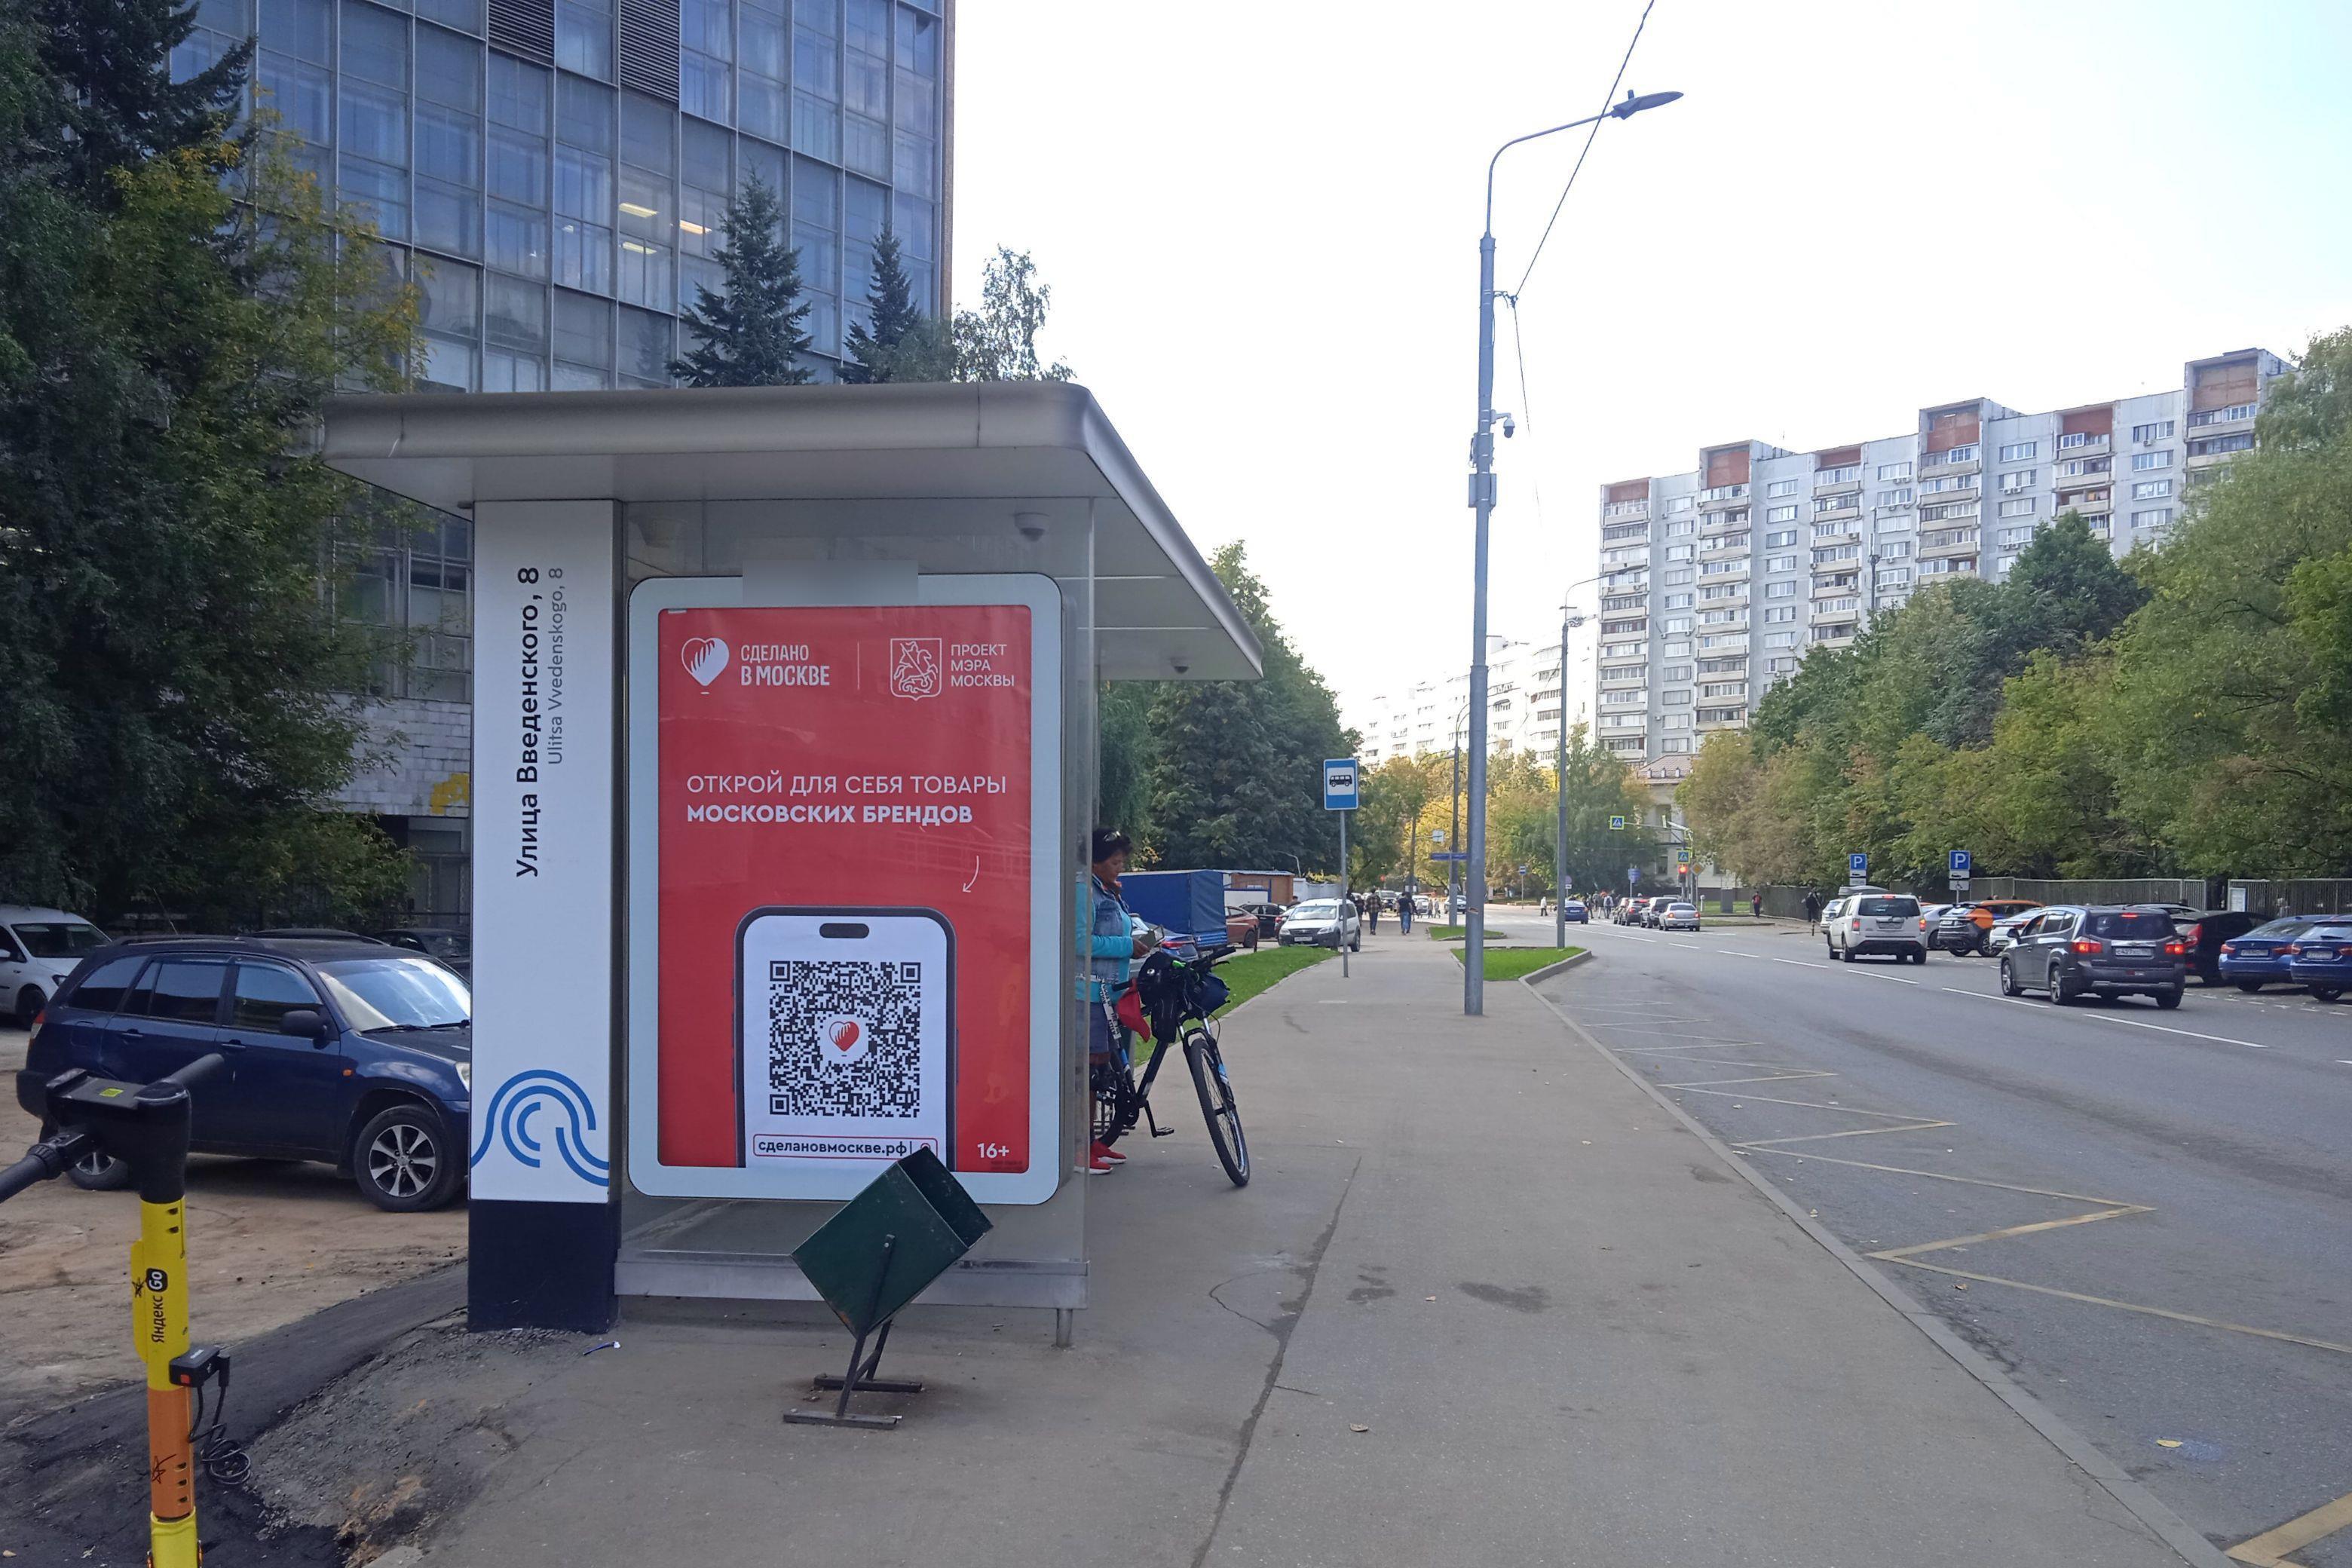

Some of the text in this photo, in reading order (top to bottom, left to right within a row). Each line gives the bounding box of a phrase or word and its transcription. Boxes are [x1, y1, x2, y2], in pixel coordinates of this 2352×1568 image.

[740, 645, 809, 664] СДЕЛАНО
[951, 644, 1008, 657] ПРОЕКТ
[547, 568, 568, 764] Ulitsa Vvedenskogo, 8
[741, 665, 830, 686] В МОСКВЕ
[951, 659, 991, 672] МЭРА
[951, 674, 1015, 687] МОСКВЫ
[516, 567, 543, 877] Улица Введенского, 8
[687, 769, 1007, 797] ОТКРОЙ ДЛЯ СЕБЯ ТОВАРЫ
[687, 804, 972, 827] МОСКОВСКИХ БРЕНДОВ
[758, 1141, 908, 1157] сделановмоскве.рф
[977, 1142, 1010, 1159] 16+
[149, 1271, 167, 1343] Яндекс Go
